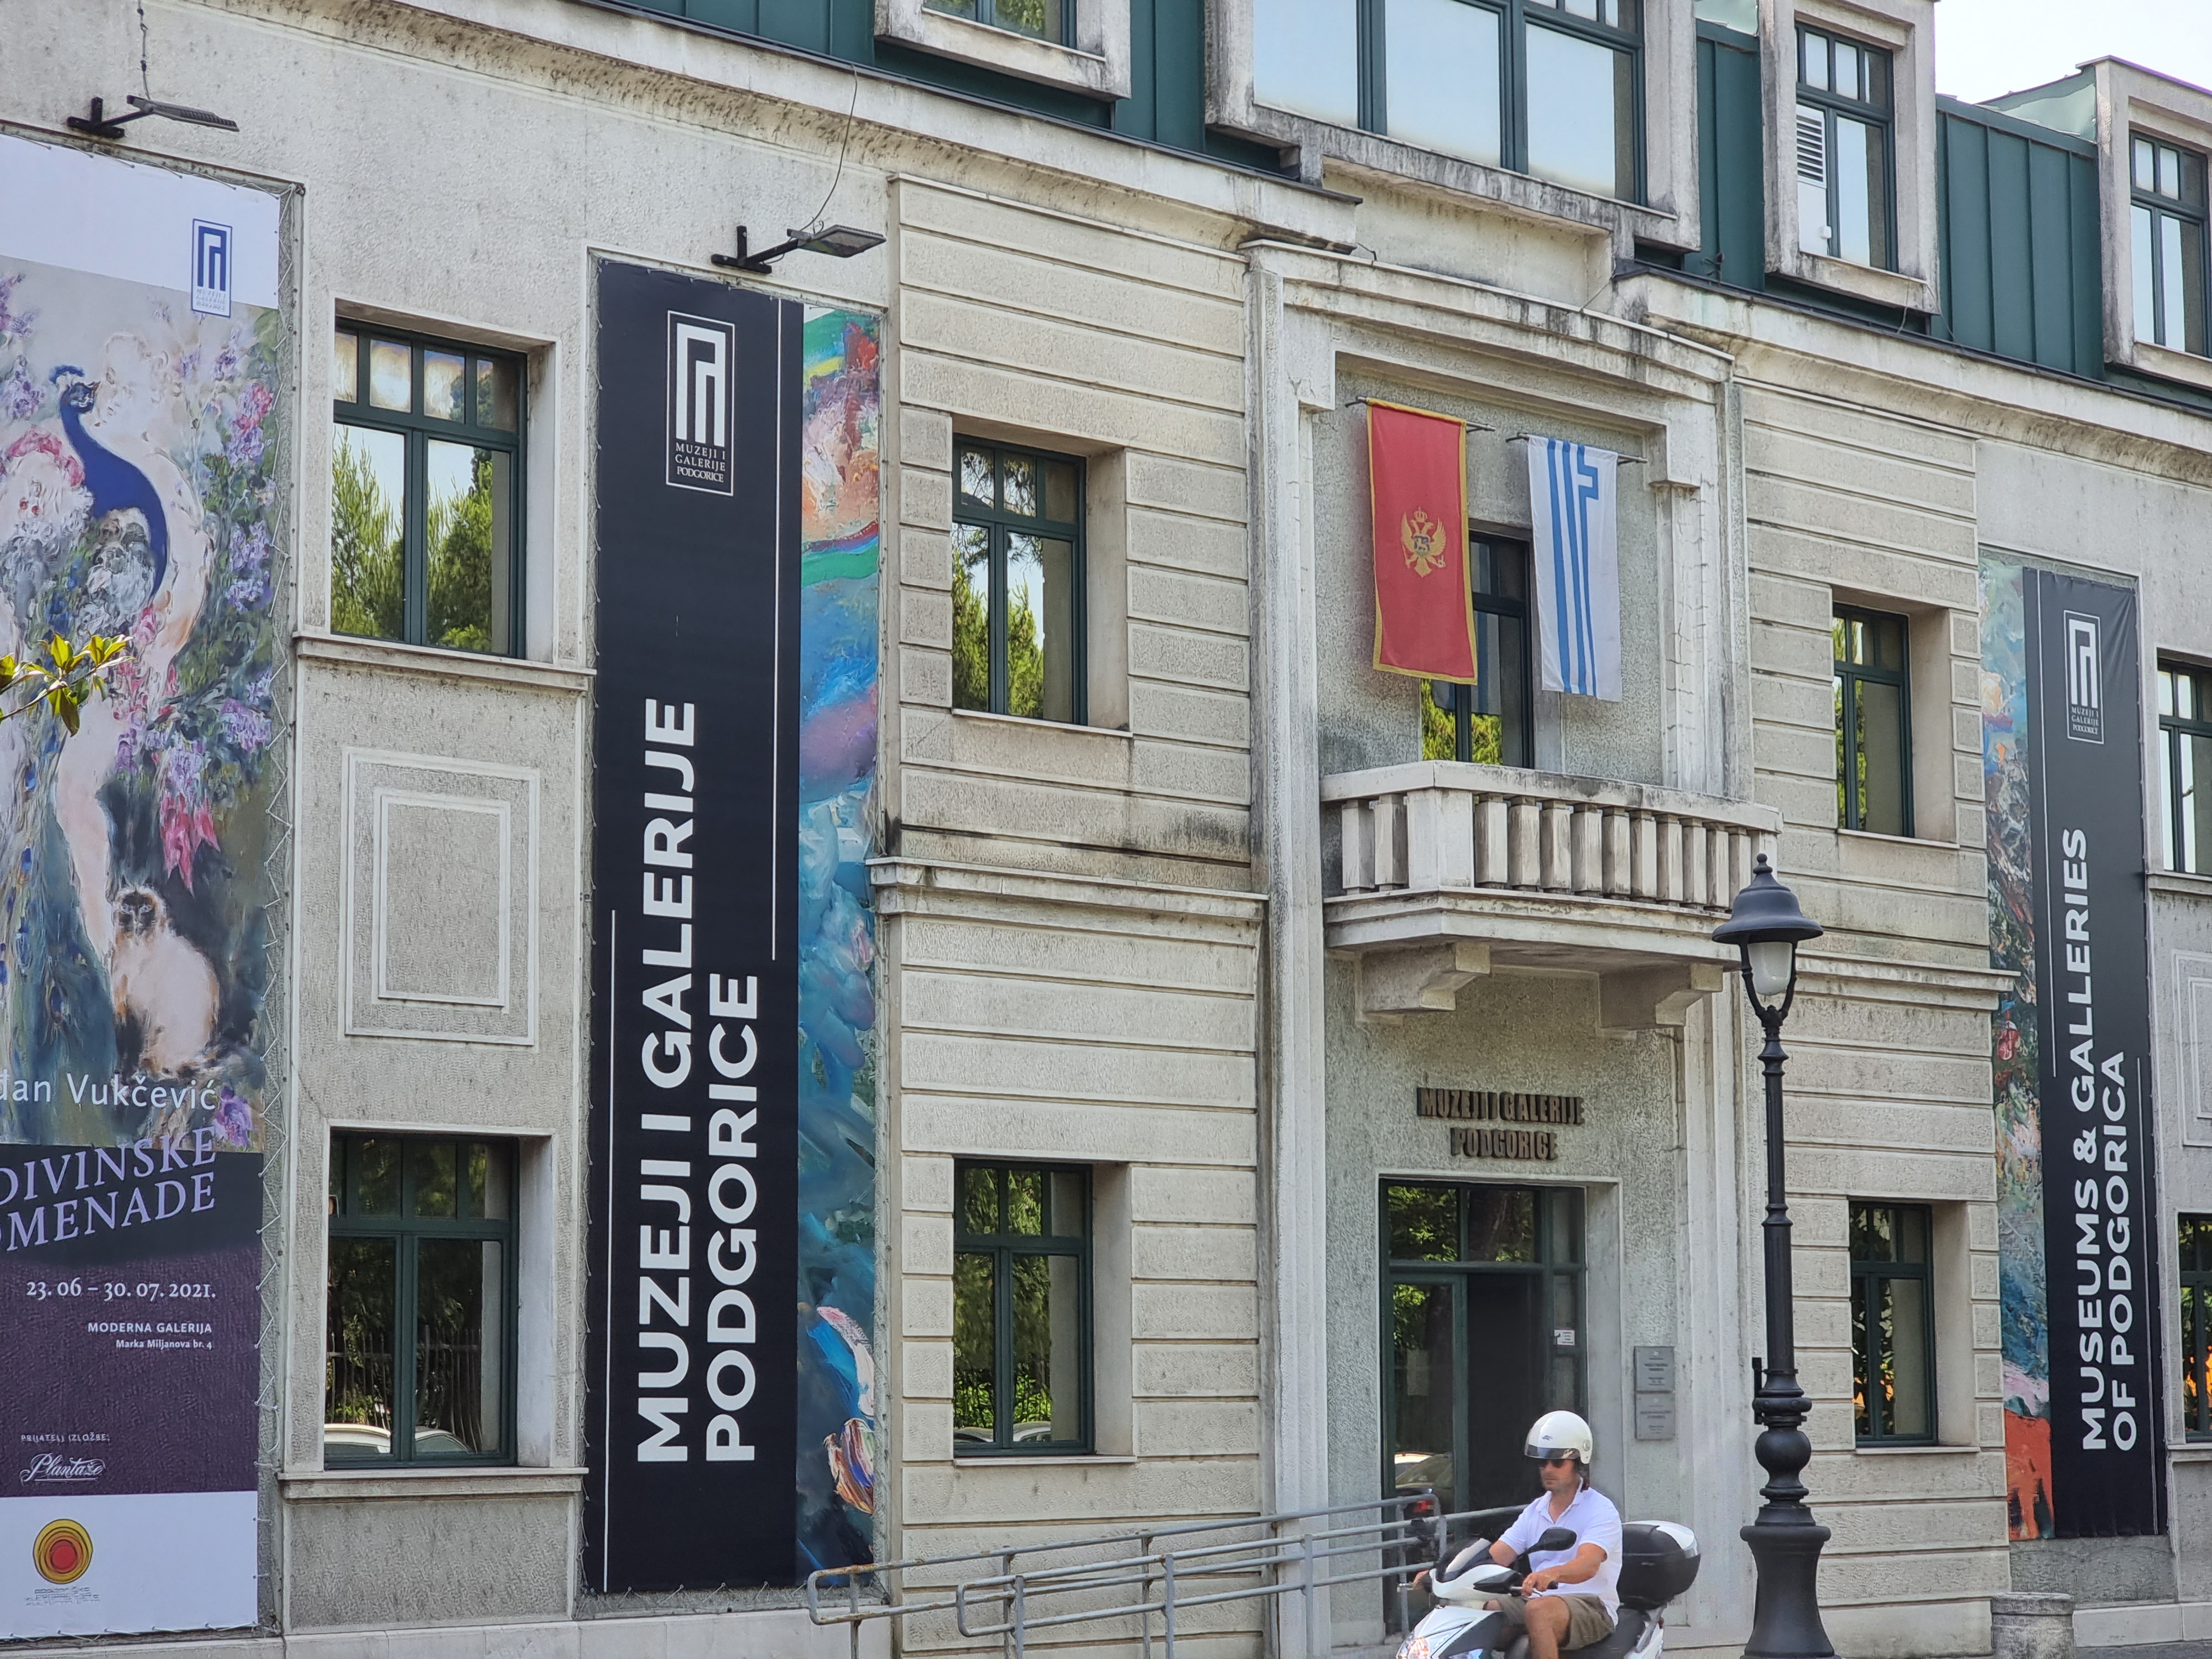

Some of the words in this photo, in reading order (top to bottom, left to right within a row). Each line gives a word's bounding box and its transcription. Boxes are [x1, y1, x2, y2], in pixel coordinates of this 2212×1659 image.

[675, 454, 726, 472] GALERIJE
[676, 442, 716, 459] MUZEJI
[722, 451, 726, 460] I
[677, 466, 723, 483] PODGORICE
[641, 698, 695, 1088] GALERIJE
[2063, 829, 2095, 1112] GALLERIES
[66, 1073, 216, 1110] Vukčević
[1417, 1088, 1486, 1119] MUZEJI
[1499, 1092, 1584, 1124] GALERIJE
[641, 1114, 691, 1131] I
[1451, 1128, 1558, 1161] PODGORICE
[2074, 1126, 2096, 1164] &
[0, 1171, 216, 1251] MENADE
[706, 973, 757, 1461] PODGORICE
[2102, 1051, 2134, 1364] PODGORICA
[87, 1322, 152, 1333] MODERNA
[156, 1323, 212, 1334] GALERIJA
[638, 1160, 691, 1462] MUZEJI
[2075, 1178, 2106, 1449] MUSEUMS
[116, 1339, 144, 1348] Marka
[147, 1339, 190, 1350] Miljanova
[194, 1339, 204, 1348] br.
[206, 1342, 212, 1350] 4
[2112, 1380, 2136, 1451] OF
